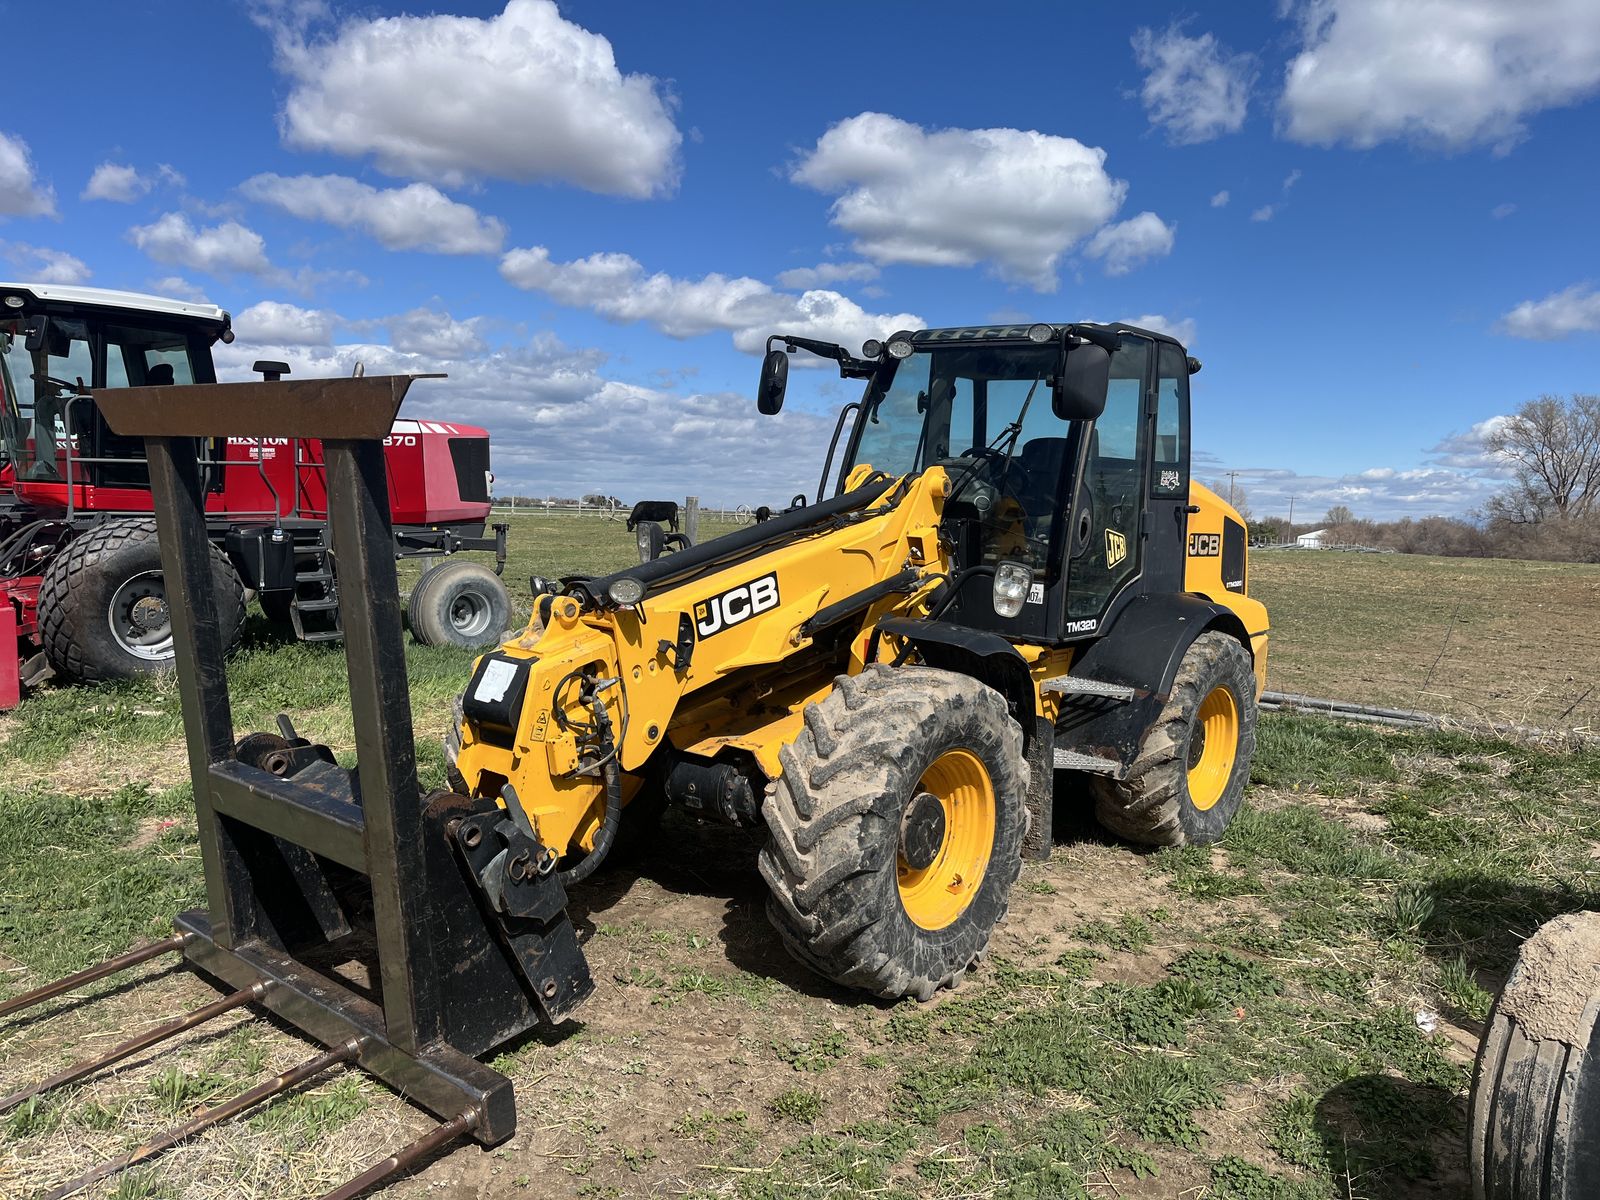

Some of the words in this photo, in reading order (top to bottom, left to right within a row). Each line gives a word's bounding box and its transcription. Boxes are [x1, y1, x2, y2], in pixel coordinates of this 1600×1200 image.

[1107, 532, 1125, 565] JCB
[1189, 535, 1220, 555] JCB
[698, 576, 779, 636] JCB
[1066, 618, 1097, 633] TM320
